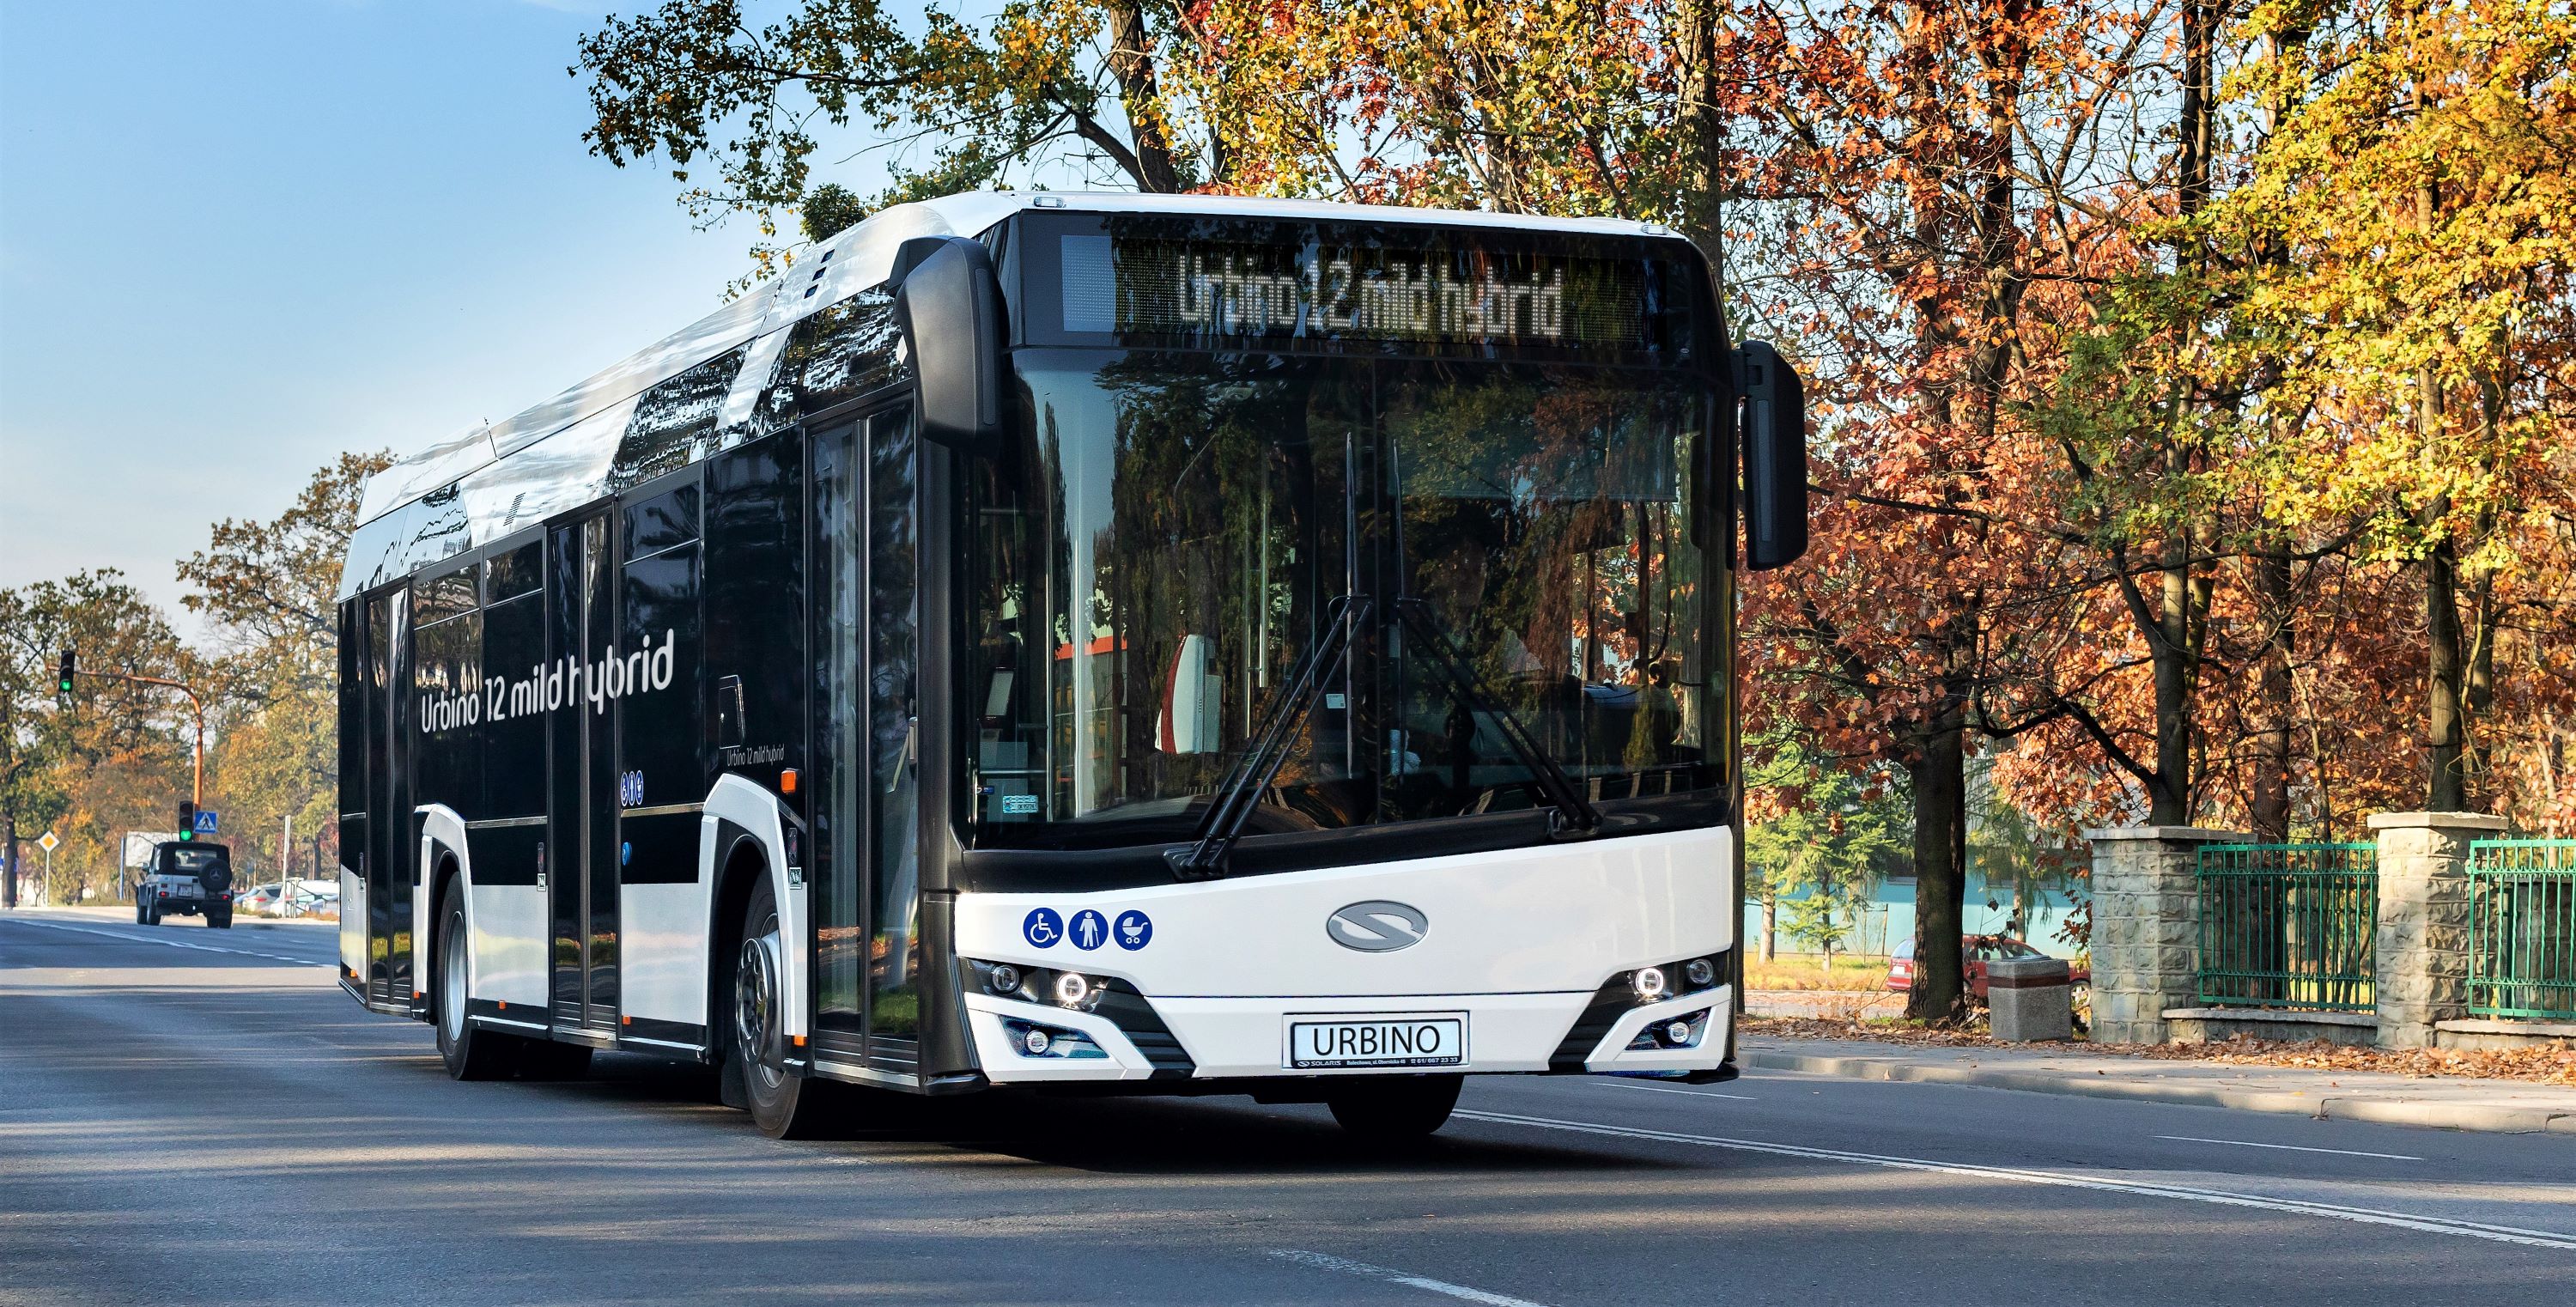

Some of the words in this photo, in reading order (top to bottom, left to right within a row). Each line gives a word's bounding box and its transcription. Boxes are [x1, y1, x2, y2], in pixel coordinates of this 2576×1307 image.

[1180, 255, 1296, 325] Urbino
[1307, 260, 1351, 327] 12
[1362, 263, 1428, 330] mild
[1442, 264, 1561, 336] hybrid
[421, 688, 479, 733] Urbino
[485, 676, 506, 722] 12
[511, 659, 563, 719] mild
[568, 628, 675, 714] hybrid
[727, 748, 746, 766] Urbino
[747, 747, 753, 765] 12
[753, 745, 766, 763] mild
[766, 743, 785, 766] hybrid
[1314, 1025, 1441, 1056] URBINO
